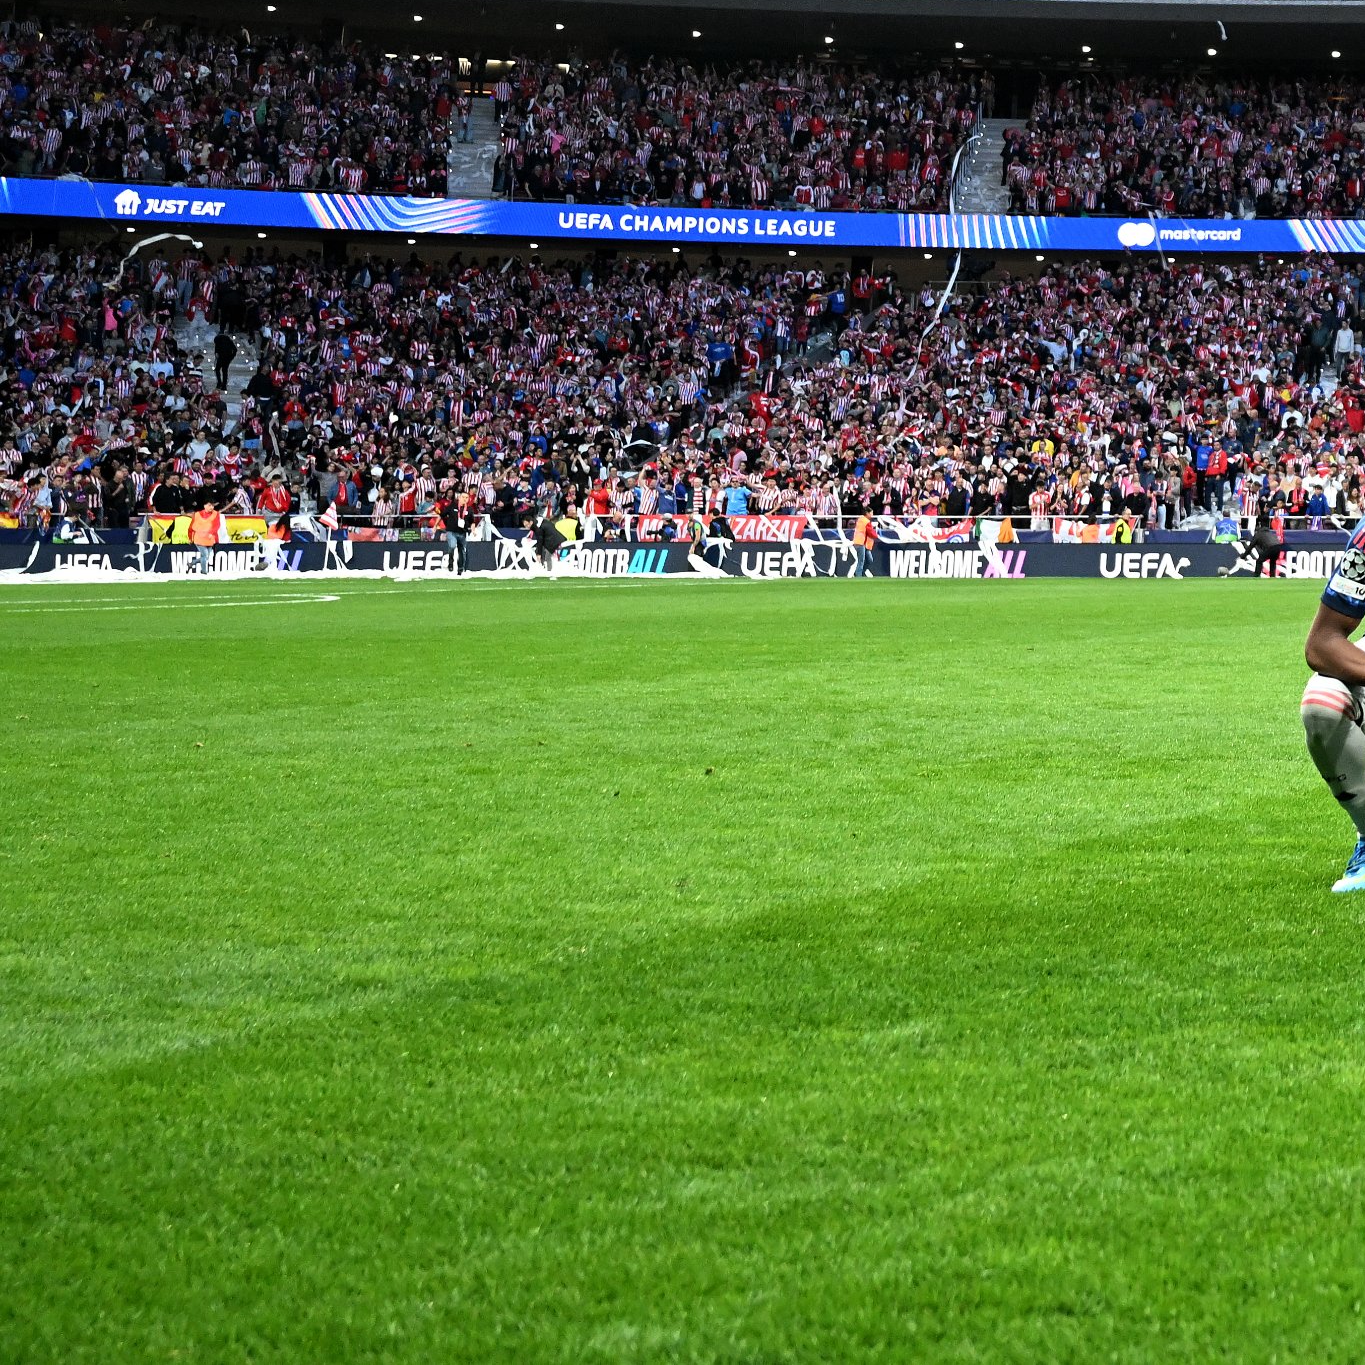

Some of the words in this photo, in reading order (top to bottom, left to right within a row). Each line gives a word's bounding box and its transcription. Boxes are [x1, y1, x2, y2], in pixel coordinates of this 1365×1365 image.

[144, 197, 189, 215] JUST
[191, 200, 226, 217] EAT
[558, 211, 614, 231] UEFA
[619, 213, 749, 235] CHAMPIONS
[754, 217, 836, 237] LEAGUE
[1160, 227, 1241, 242] mastercard
[1100, 552, 1174, 578] UEFA
